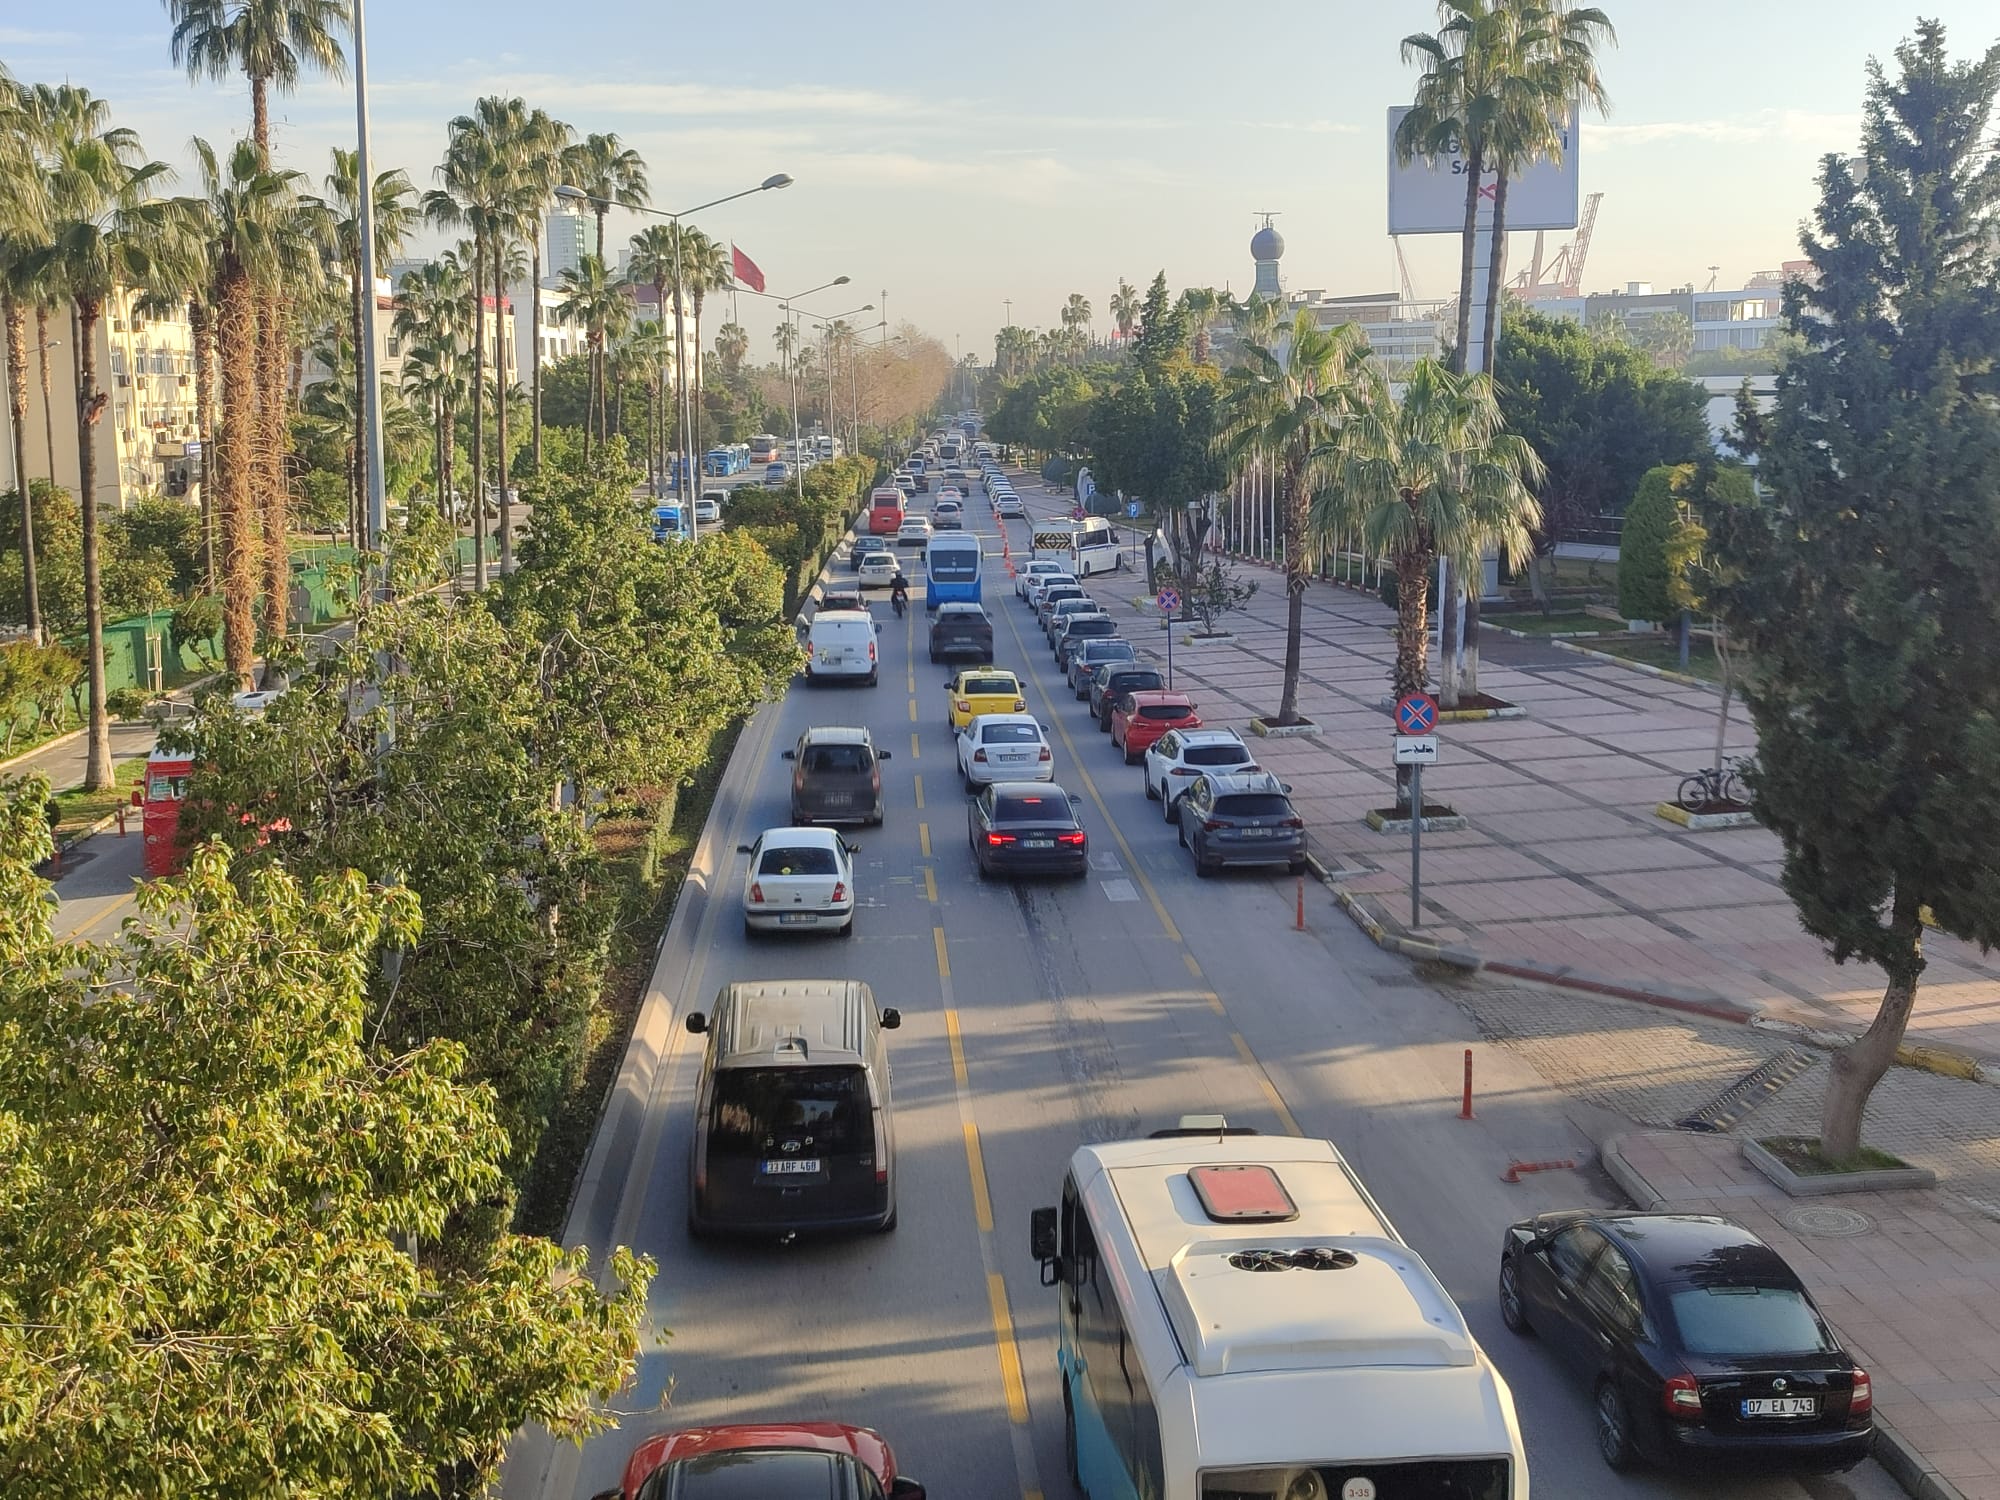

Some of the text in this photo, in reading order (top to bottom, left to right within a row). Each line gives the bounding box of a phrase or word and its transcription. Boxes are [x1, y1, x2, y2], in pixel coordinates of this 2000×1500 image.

[1130, 504, 1137, 516] P
[1749, 1399, 1812, 1412] 07 EA 743
